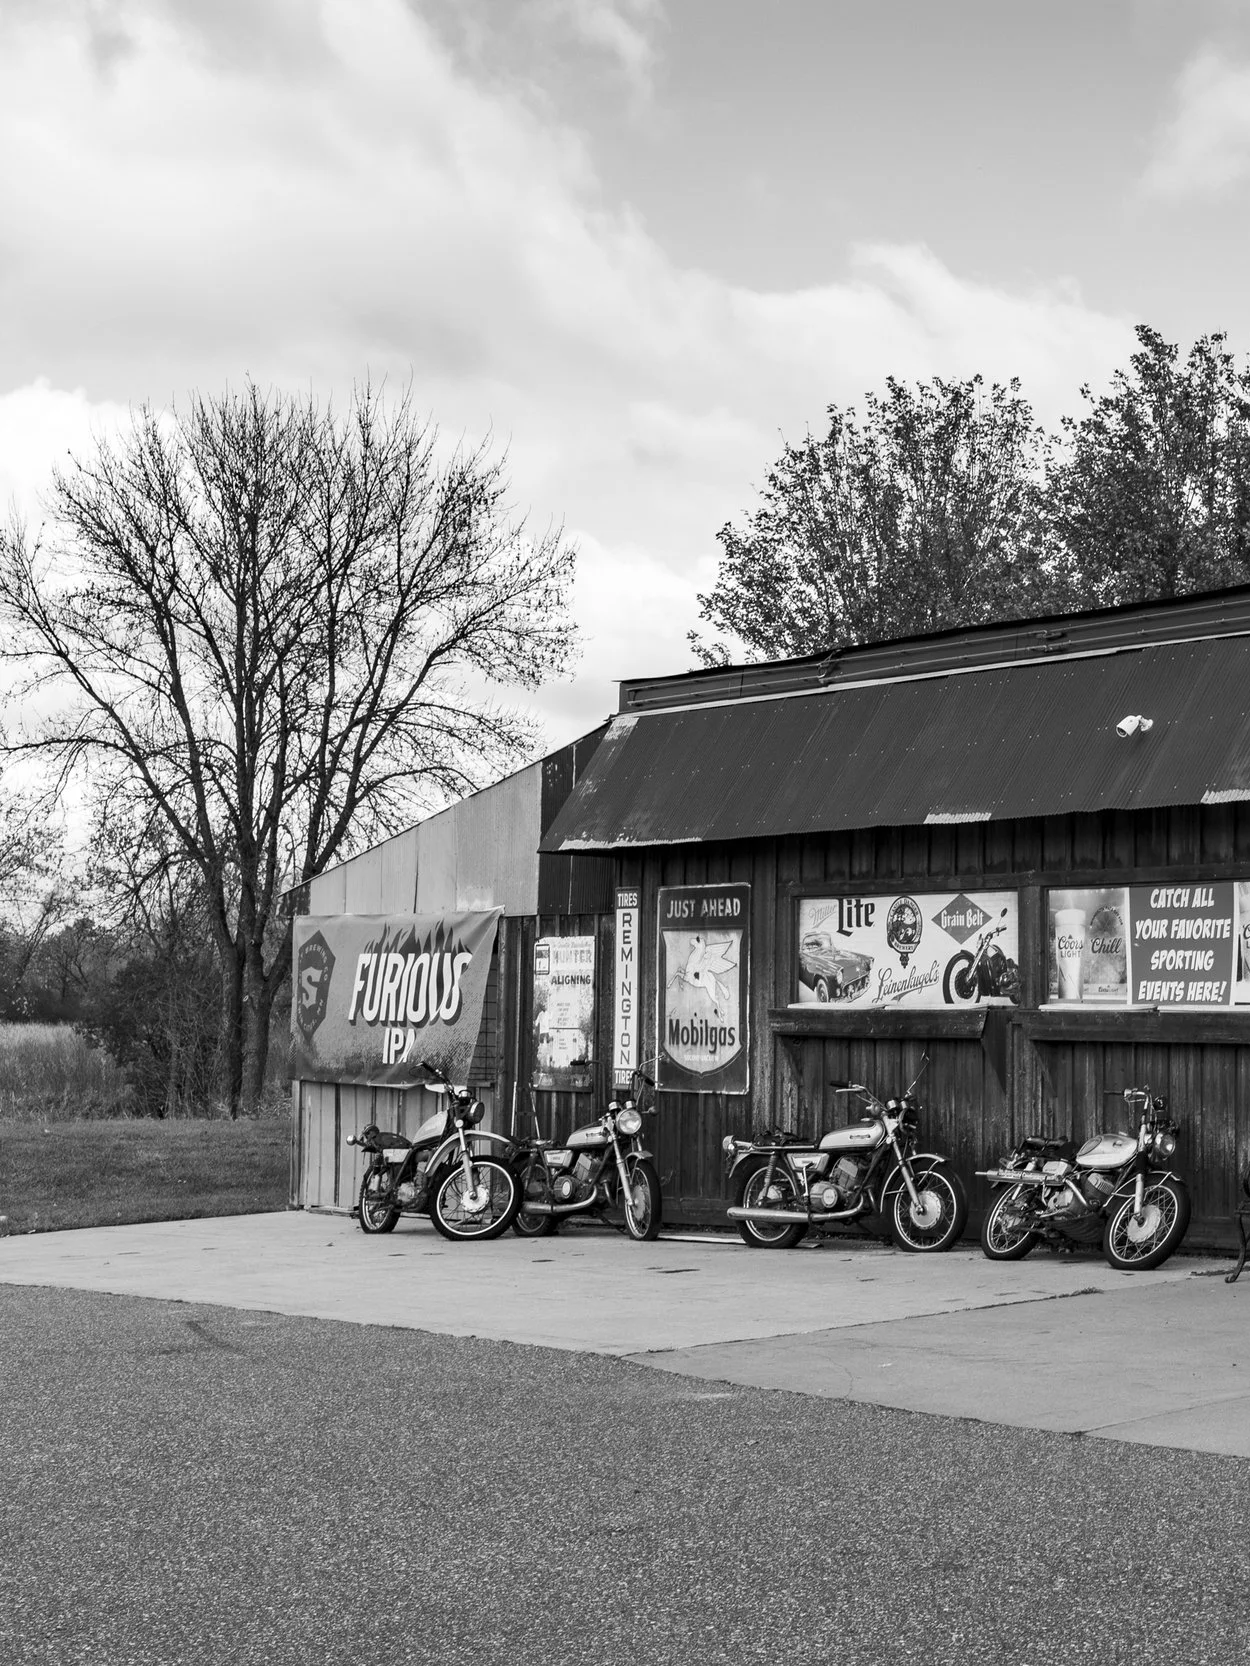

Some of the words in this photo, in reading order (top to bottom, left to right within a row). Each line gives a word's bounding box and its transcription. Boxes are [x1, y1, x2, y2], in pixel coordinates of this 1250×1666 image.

[617, 893, 638, 907] TIRES
[666, 899, 695, 918] JUST
[701, 898, 741, 917] AHEAD
[1150, 888, 1190, 908] CATCH
[1191, 887, 1214, 908] ALL
[836, 898, 875, 937] Lite
[941, 910, 965, 929] Grain
[966, 910, 984, 927] Belt
[1135, 918, 1168, 939] YOUR
[1170, 918, 1231, 939] FAVORITE
[1058, 935, 1083, 950] Coors
[1091, 938, 1122, 954] Chill
[1060, 950, 1081, 958] LIGHT
[1150, 949, 1214, 971] SPORTING
[348, 952, 473, 1023] FURIOUS
[551, 974, 591, 985] ALIGNING
[620, 912, 633, 1065] REMINGTON
[1138, 981, 1185, 1002] EVENTS
[1187, 981, 1227, 1003] HERE!
[382, 1028, 416, 1064] IPA
[668, 1018, 736, 1053] Mobilgas
